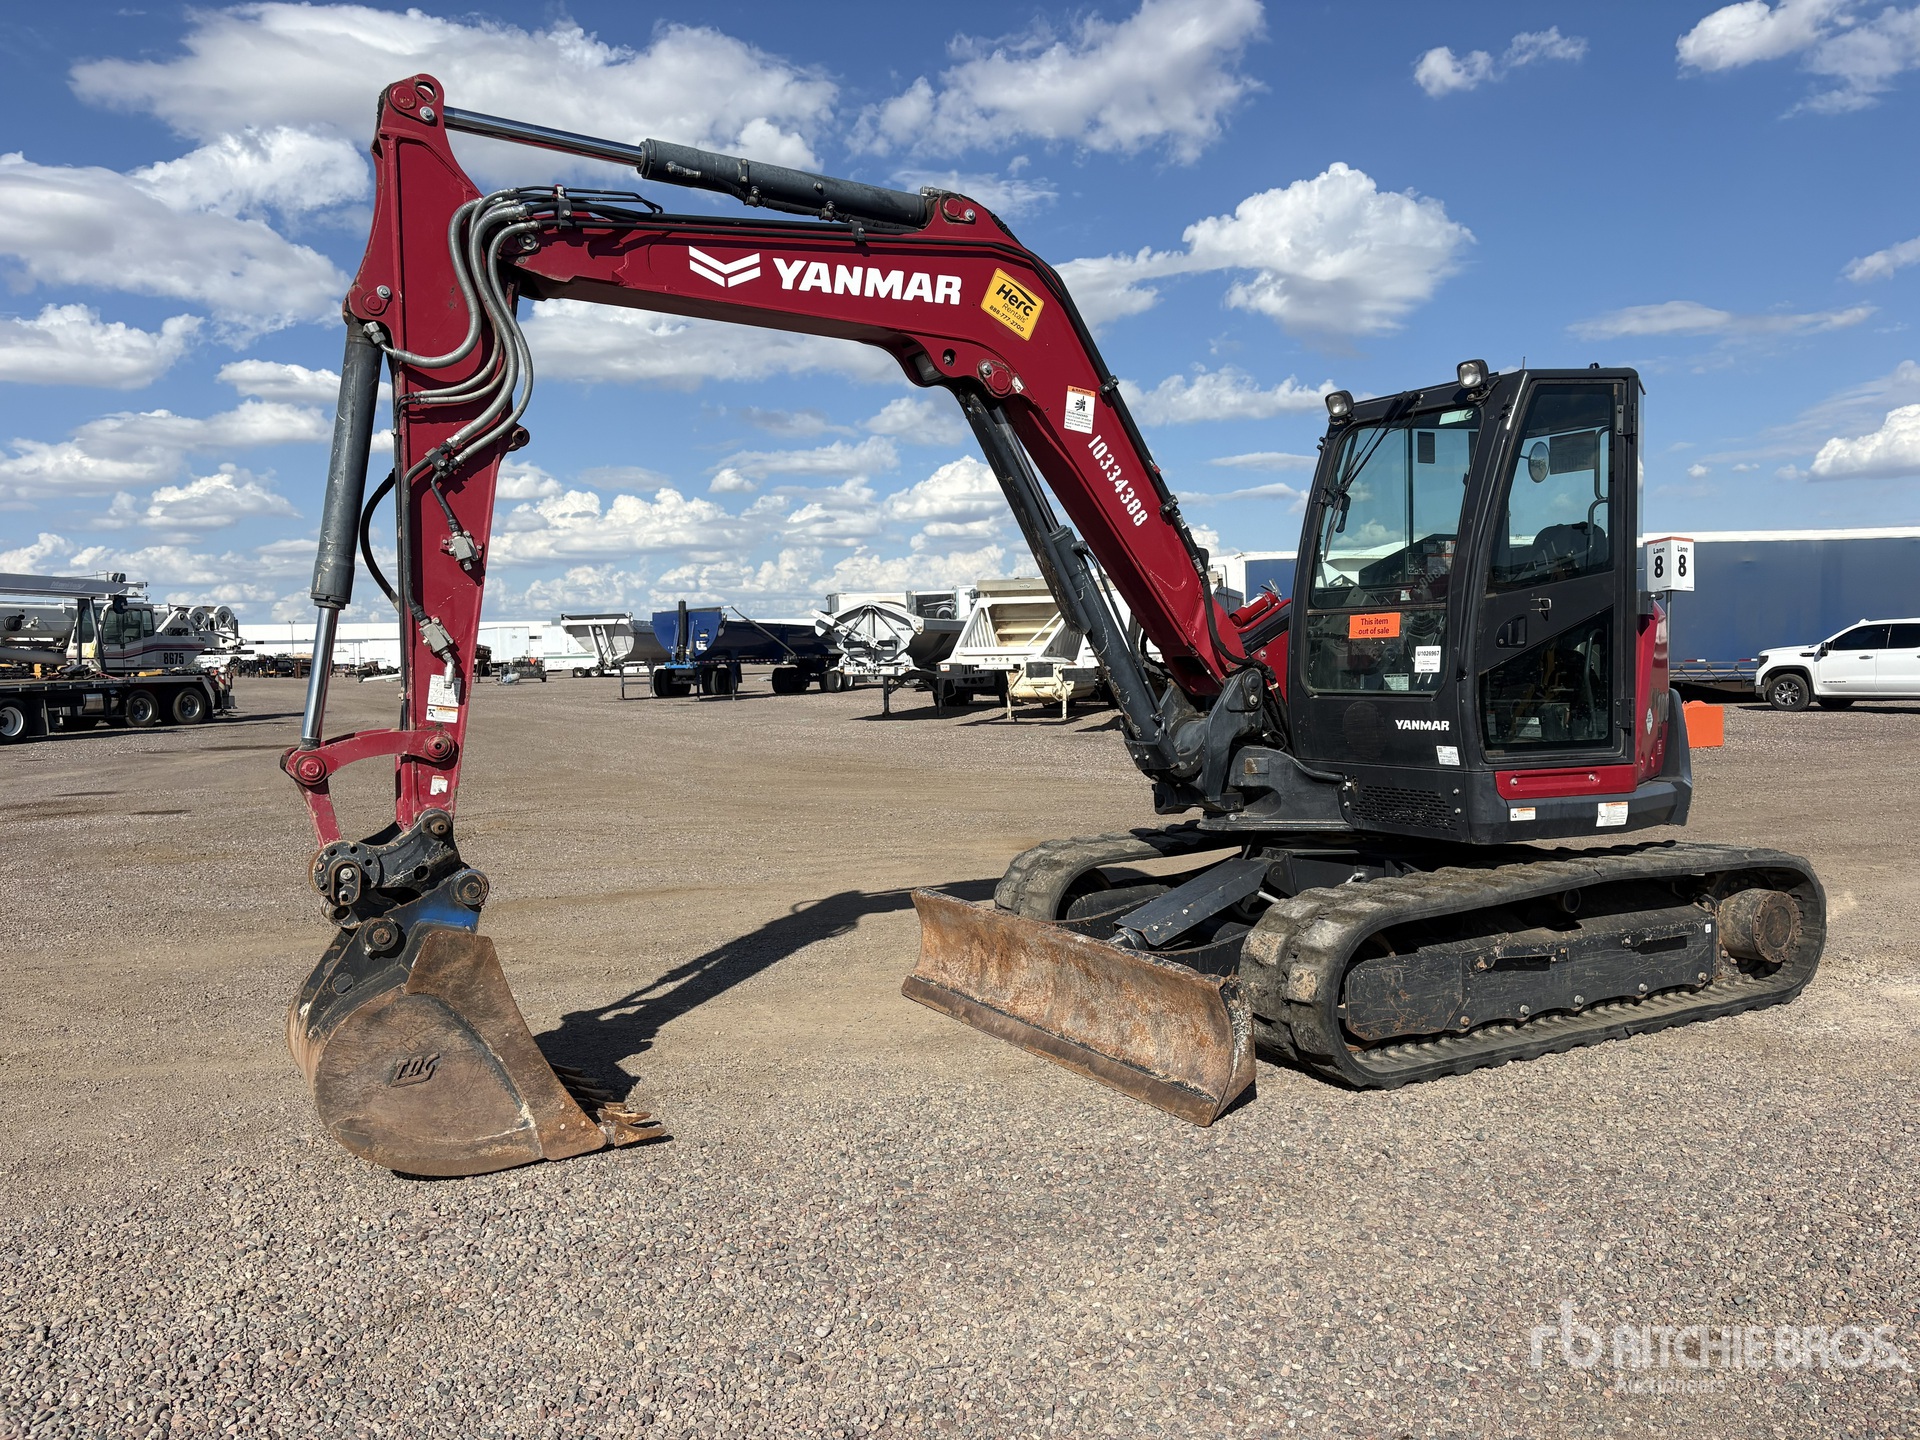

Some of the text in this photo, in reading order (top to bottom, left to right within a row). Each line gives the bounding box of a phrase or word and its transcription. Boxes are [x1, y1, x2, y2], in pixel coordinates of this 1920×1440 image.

[773, 257, 963, 306] YANMAR
[996, 283, 1034, 317] Herc
[989, 305, 1025, 332] 888-777-2700
[1002, 303, 1027, 324] Rentals
[1087, 434, 1148, 527] 10334388
[1677, 545, 1688, 553] Lane
[1654, 555, 1664, 578] 8
[1678, 554, 1687, 577] 8
[1361, 617, 1389, 626] This item
[1370, 627, 1377, 635] of
[1377, 627, 1390, 635] sale
[163, 652, 185, 665] 8675
[1395, 719, 1450, 731] YANMAR
